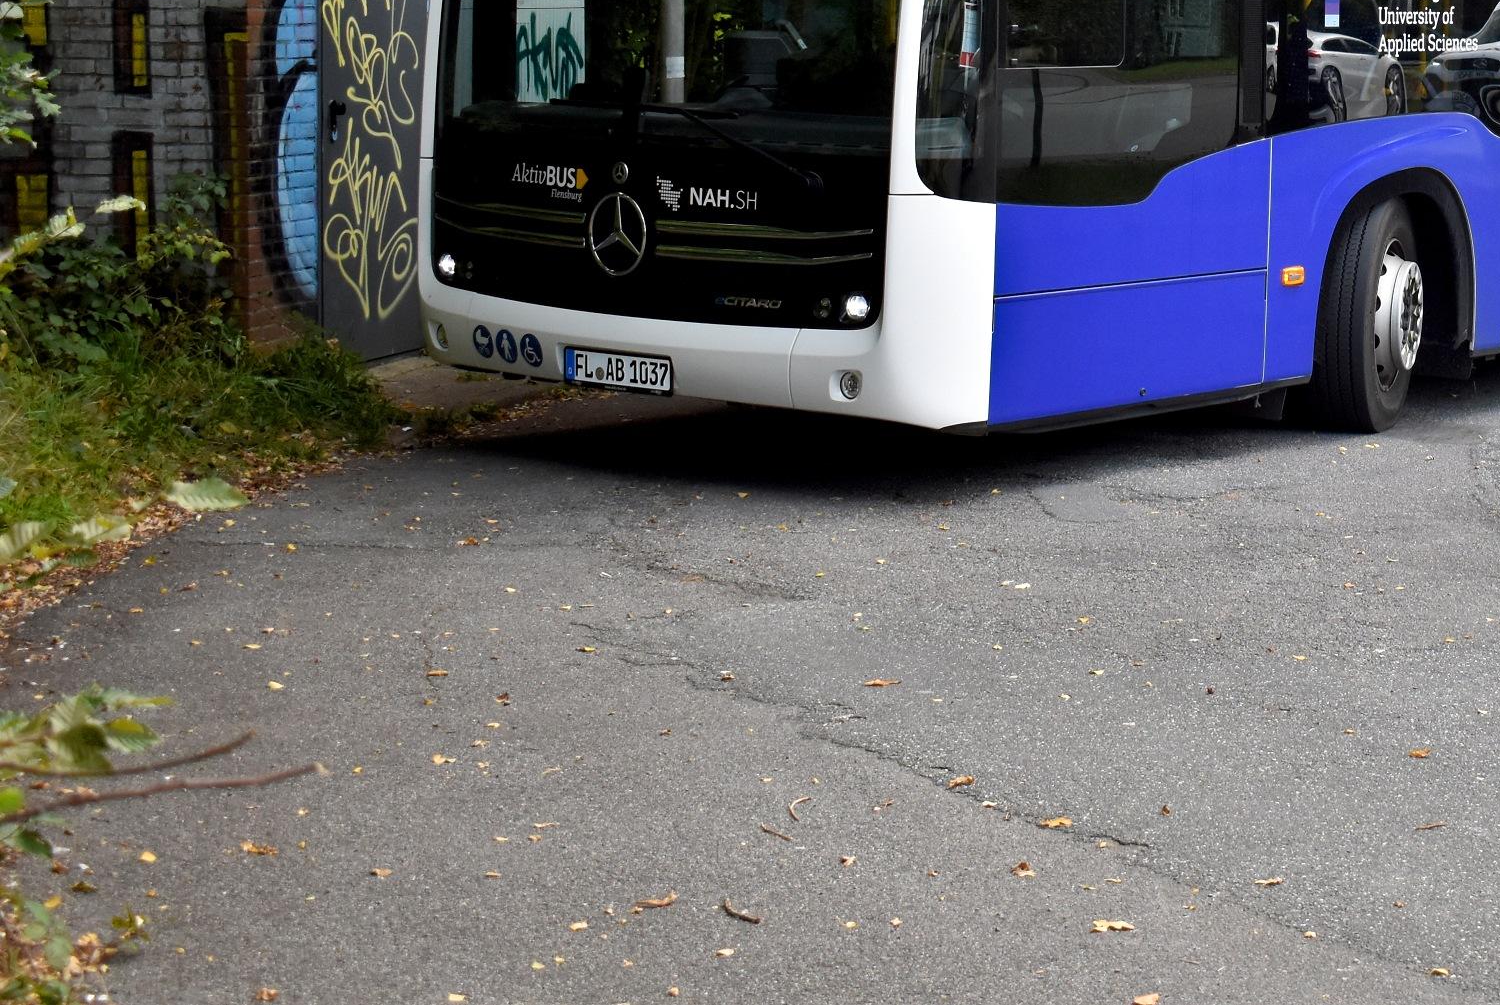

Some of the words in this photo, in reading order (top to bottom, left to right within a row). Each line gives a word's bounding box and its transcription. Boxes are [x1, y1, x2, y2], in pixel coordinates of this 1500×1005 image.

[1378, 6, 1440, 30] University
[1442, 6, 1455, 25] of
[1378, 33, 1425, 58] Applied
[1427, 33, 1479, 52] Sciences
[512, 162, 576, 189] AktivBUS
[551, 189, 582, 203] Flensburg
[689, 187, 757, 210] NAH.SH
[575, 354, 593, 378] FL
[606, 357, 625, 382] AB
[630, 360, 669, 387] 1037
